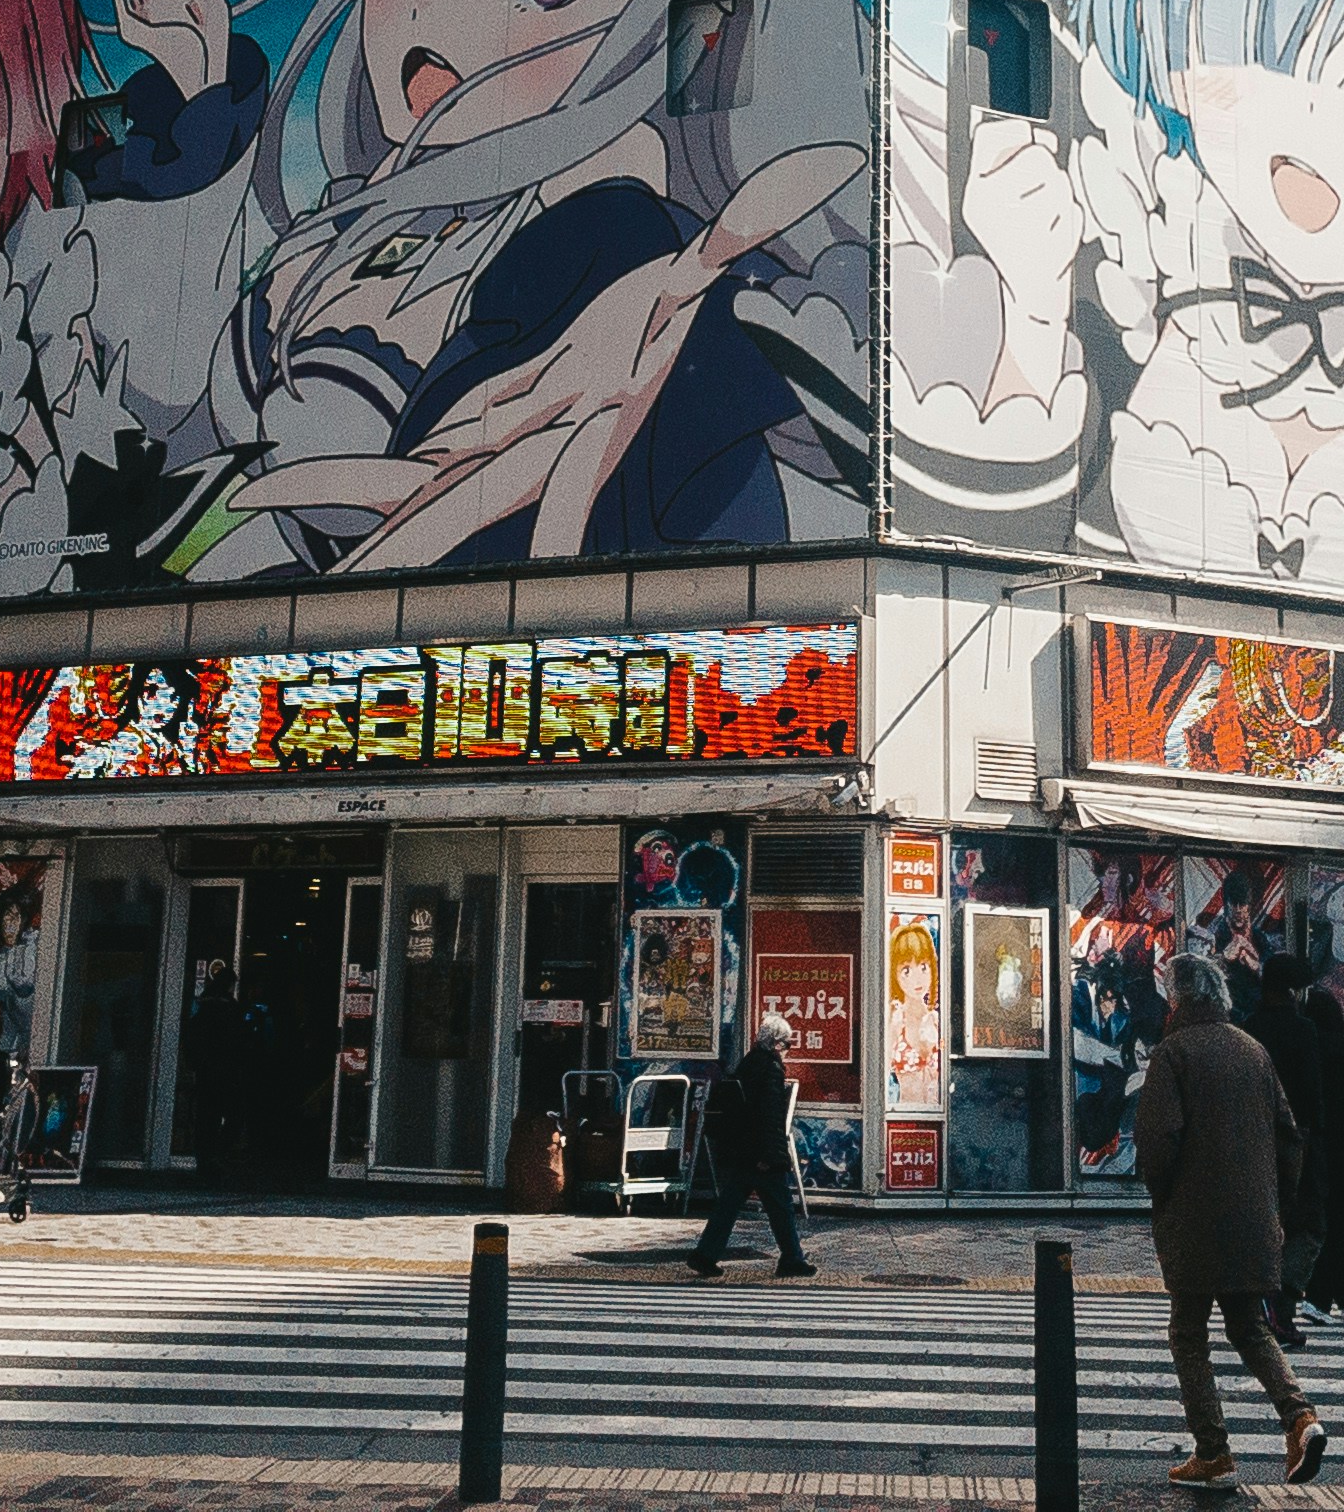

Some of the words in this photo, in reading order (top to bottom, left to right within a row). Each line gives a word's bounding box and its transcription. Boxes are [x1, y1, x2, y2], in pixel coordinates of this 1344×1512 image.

[337, 799, 387, 813] ESPACE
[892, 859, 935, 876] エスパス
[761, 989, 847, 1021] エスパス
[892, 1149, 935, 1167] エスパス
